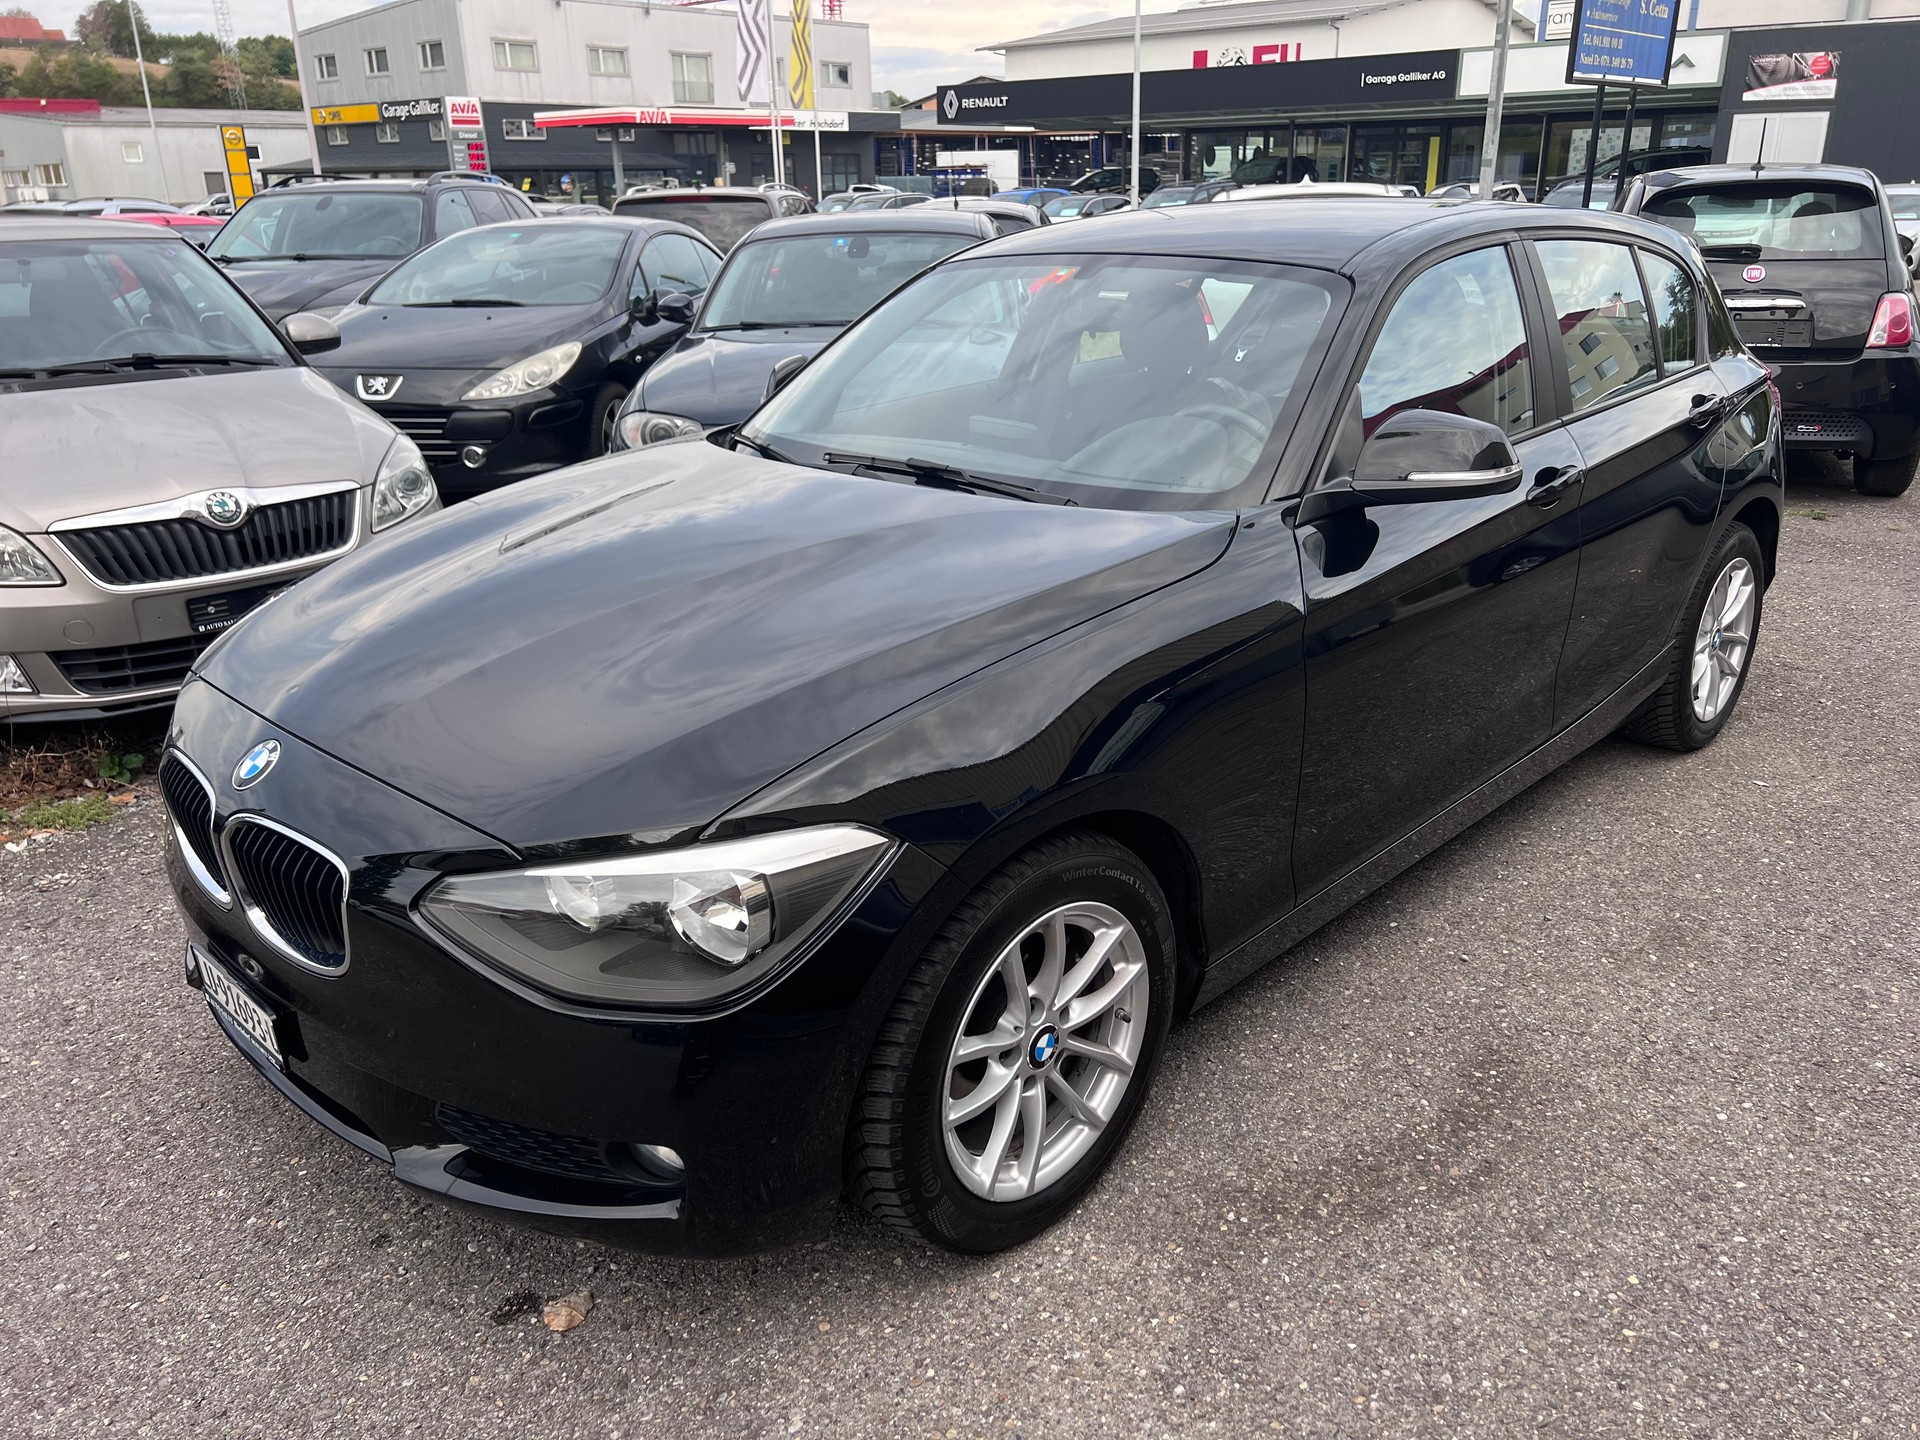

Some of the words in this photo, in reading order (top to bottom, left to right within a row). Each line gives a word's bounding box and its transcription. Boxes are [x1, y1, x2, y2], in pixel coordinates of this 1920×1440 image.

[1366, 75, 1397, 85] Garage
[1398, 72, 1431, 82] Galliker
[1432, 70, 1446, 80] AG
[450, 101, 479, 115] AVIA
[961, 96, 1009, 109] RENAULT
[381, 103, 409, 121] Garage
[409, 100, 440, 116] Galliker
[637, 107, 671, 124] AVIA
[1746, 268, 1762, 279] FIAT
[206, 621, 224, 631] AUTO
